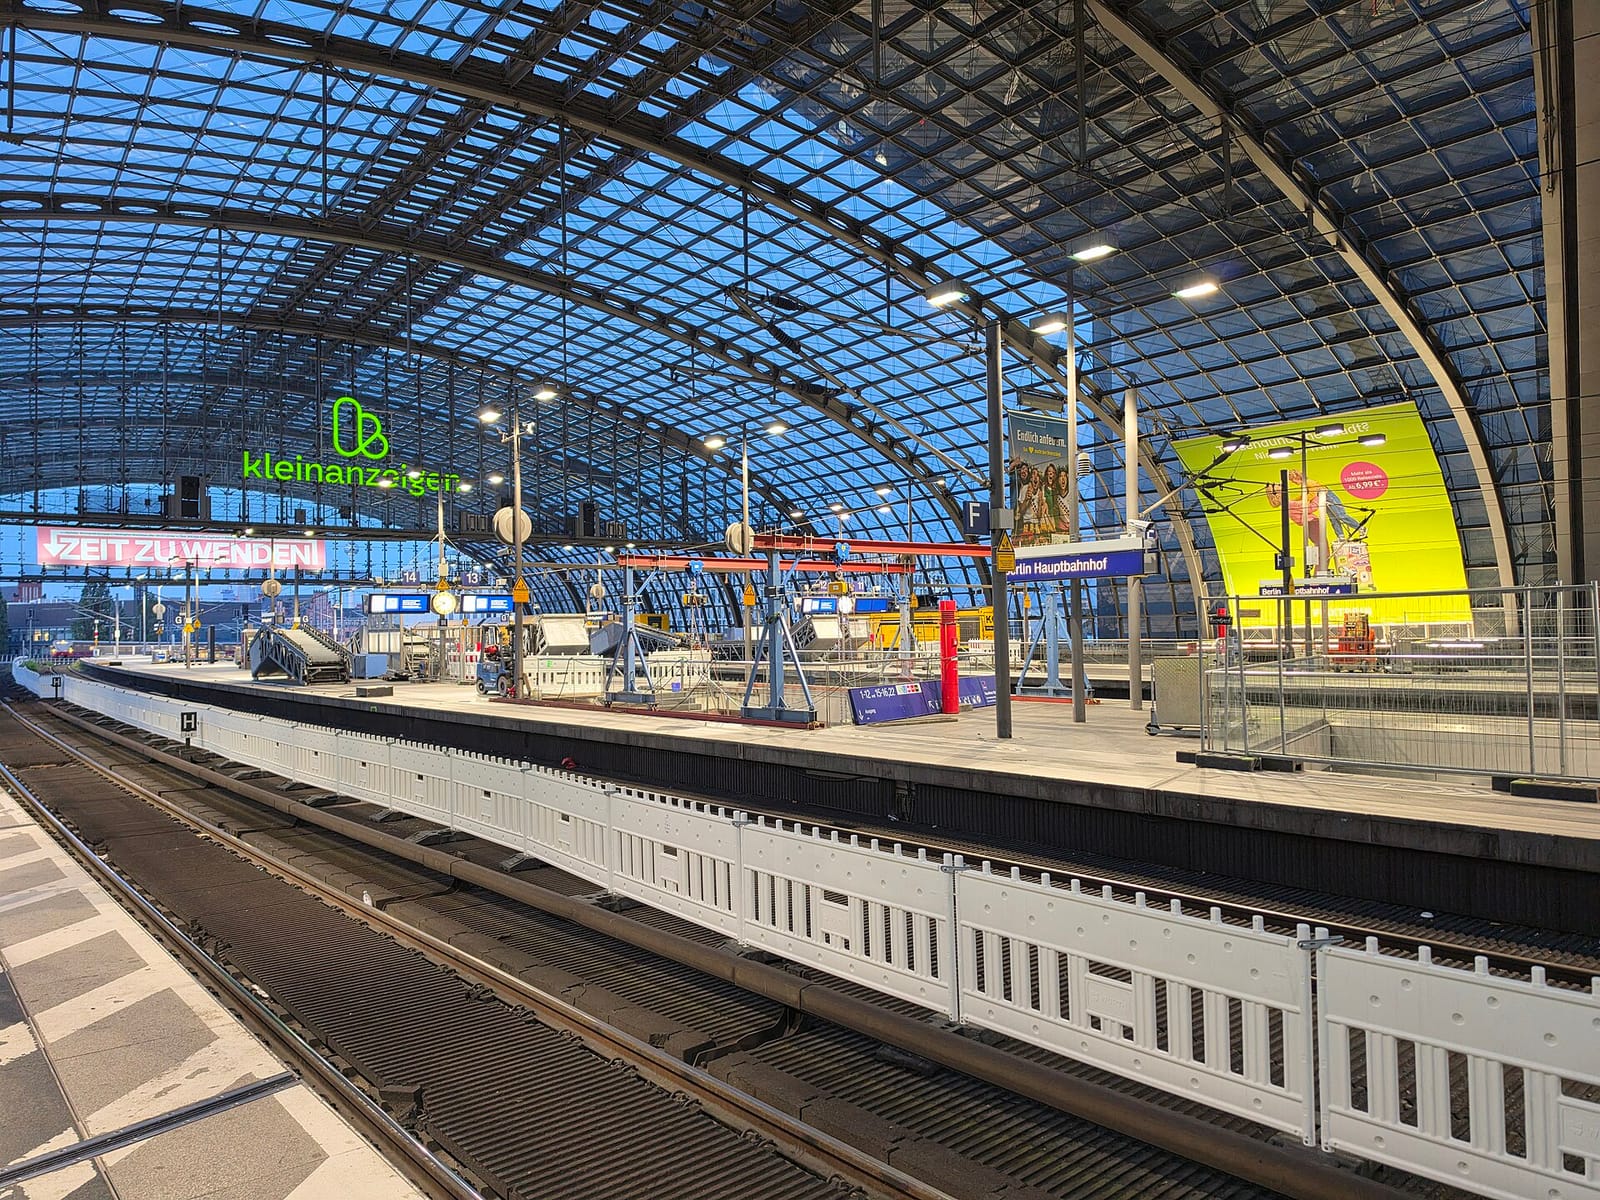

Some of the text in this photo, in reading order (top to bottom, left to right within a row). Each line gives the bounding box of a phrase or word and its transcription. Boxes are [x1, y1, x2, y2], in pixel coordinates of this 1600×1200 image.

[1017, 430, 1038, 443] Endlich
[242, 451, 461, 497] kleinanzeigen
[969, 502, 981, 528] F
[60, 537, 130, 561] ZEIT
[134, 540, 175, 563] ZU
[1034, 557, 1108, 576] Hauptbahnhof
[403, 571, 417, 583] 14
[466, 572, 479, 584] 13
[1261, 587, 1282, 596] Berlin
[183, 714, 195, 729] H
